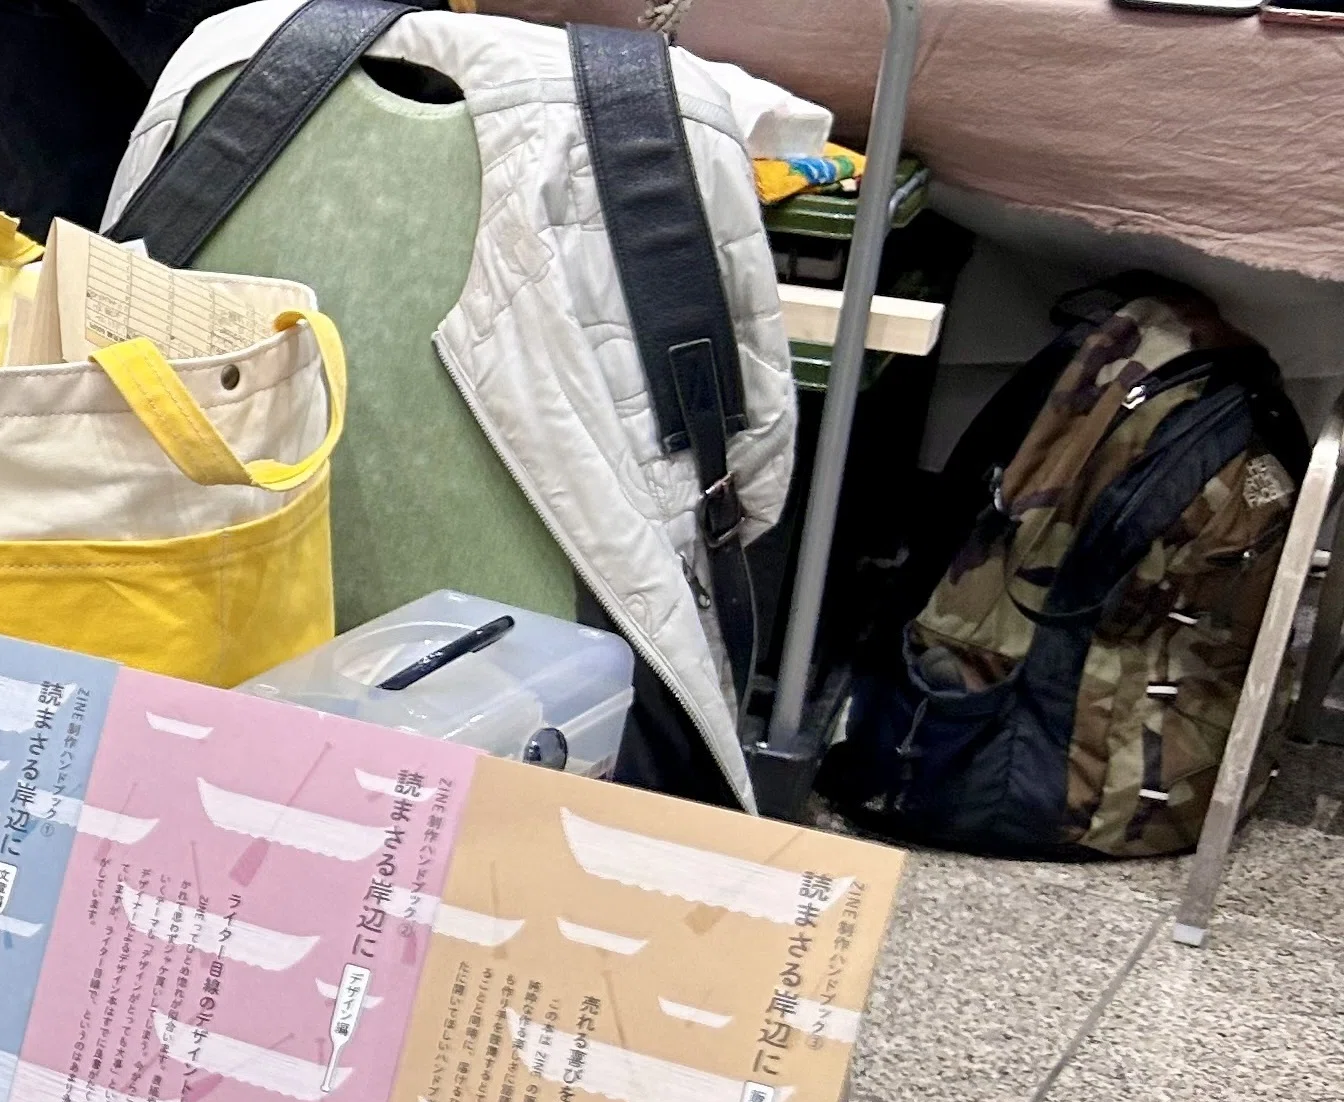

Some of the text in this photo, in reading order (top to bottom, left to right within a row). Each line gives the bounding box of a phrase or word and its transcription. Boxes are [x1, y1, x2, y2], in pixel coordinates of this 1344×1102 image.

[0, 680, 65, 859] 読まさる岸辺に
[351, 768, 426, 963] 読まさる岸辺に
[335, 971, 364, 1038] デザイン編
[750, 870, 833, 1080] 読まさる岸辺に
